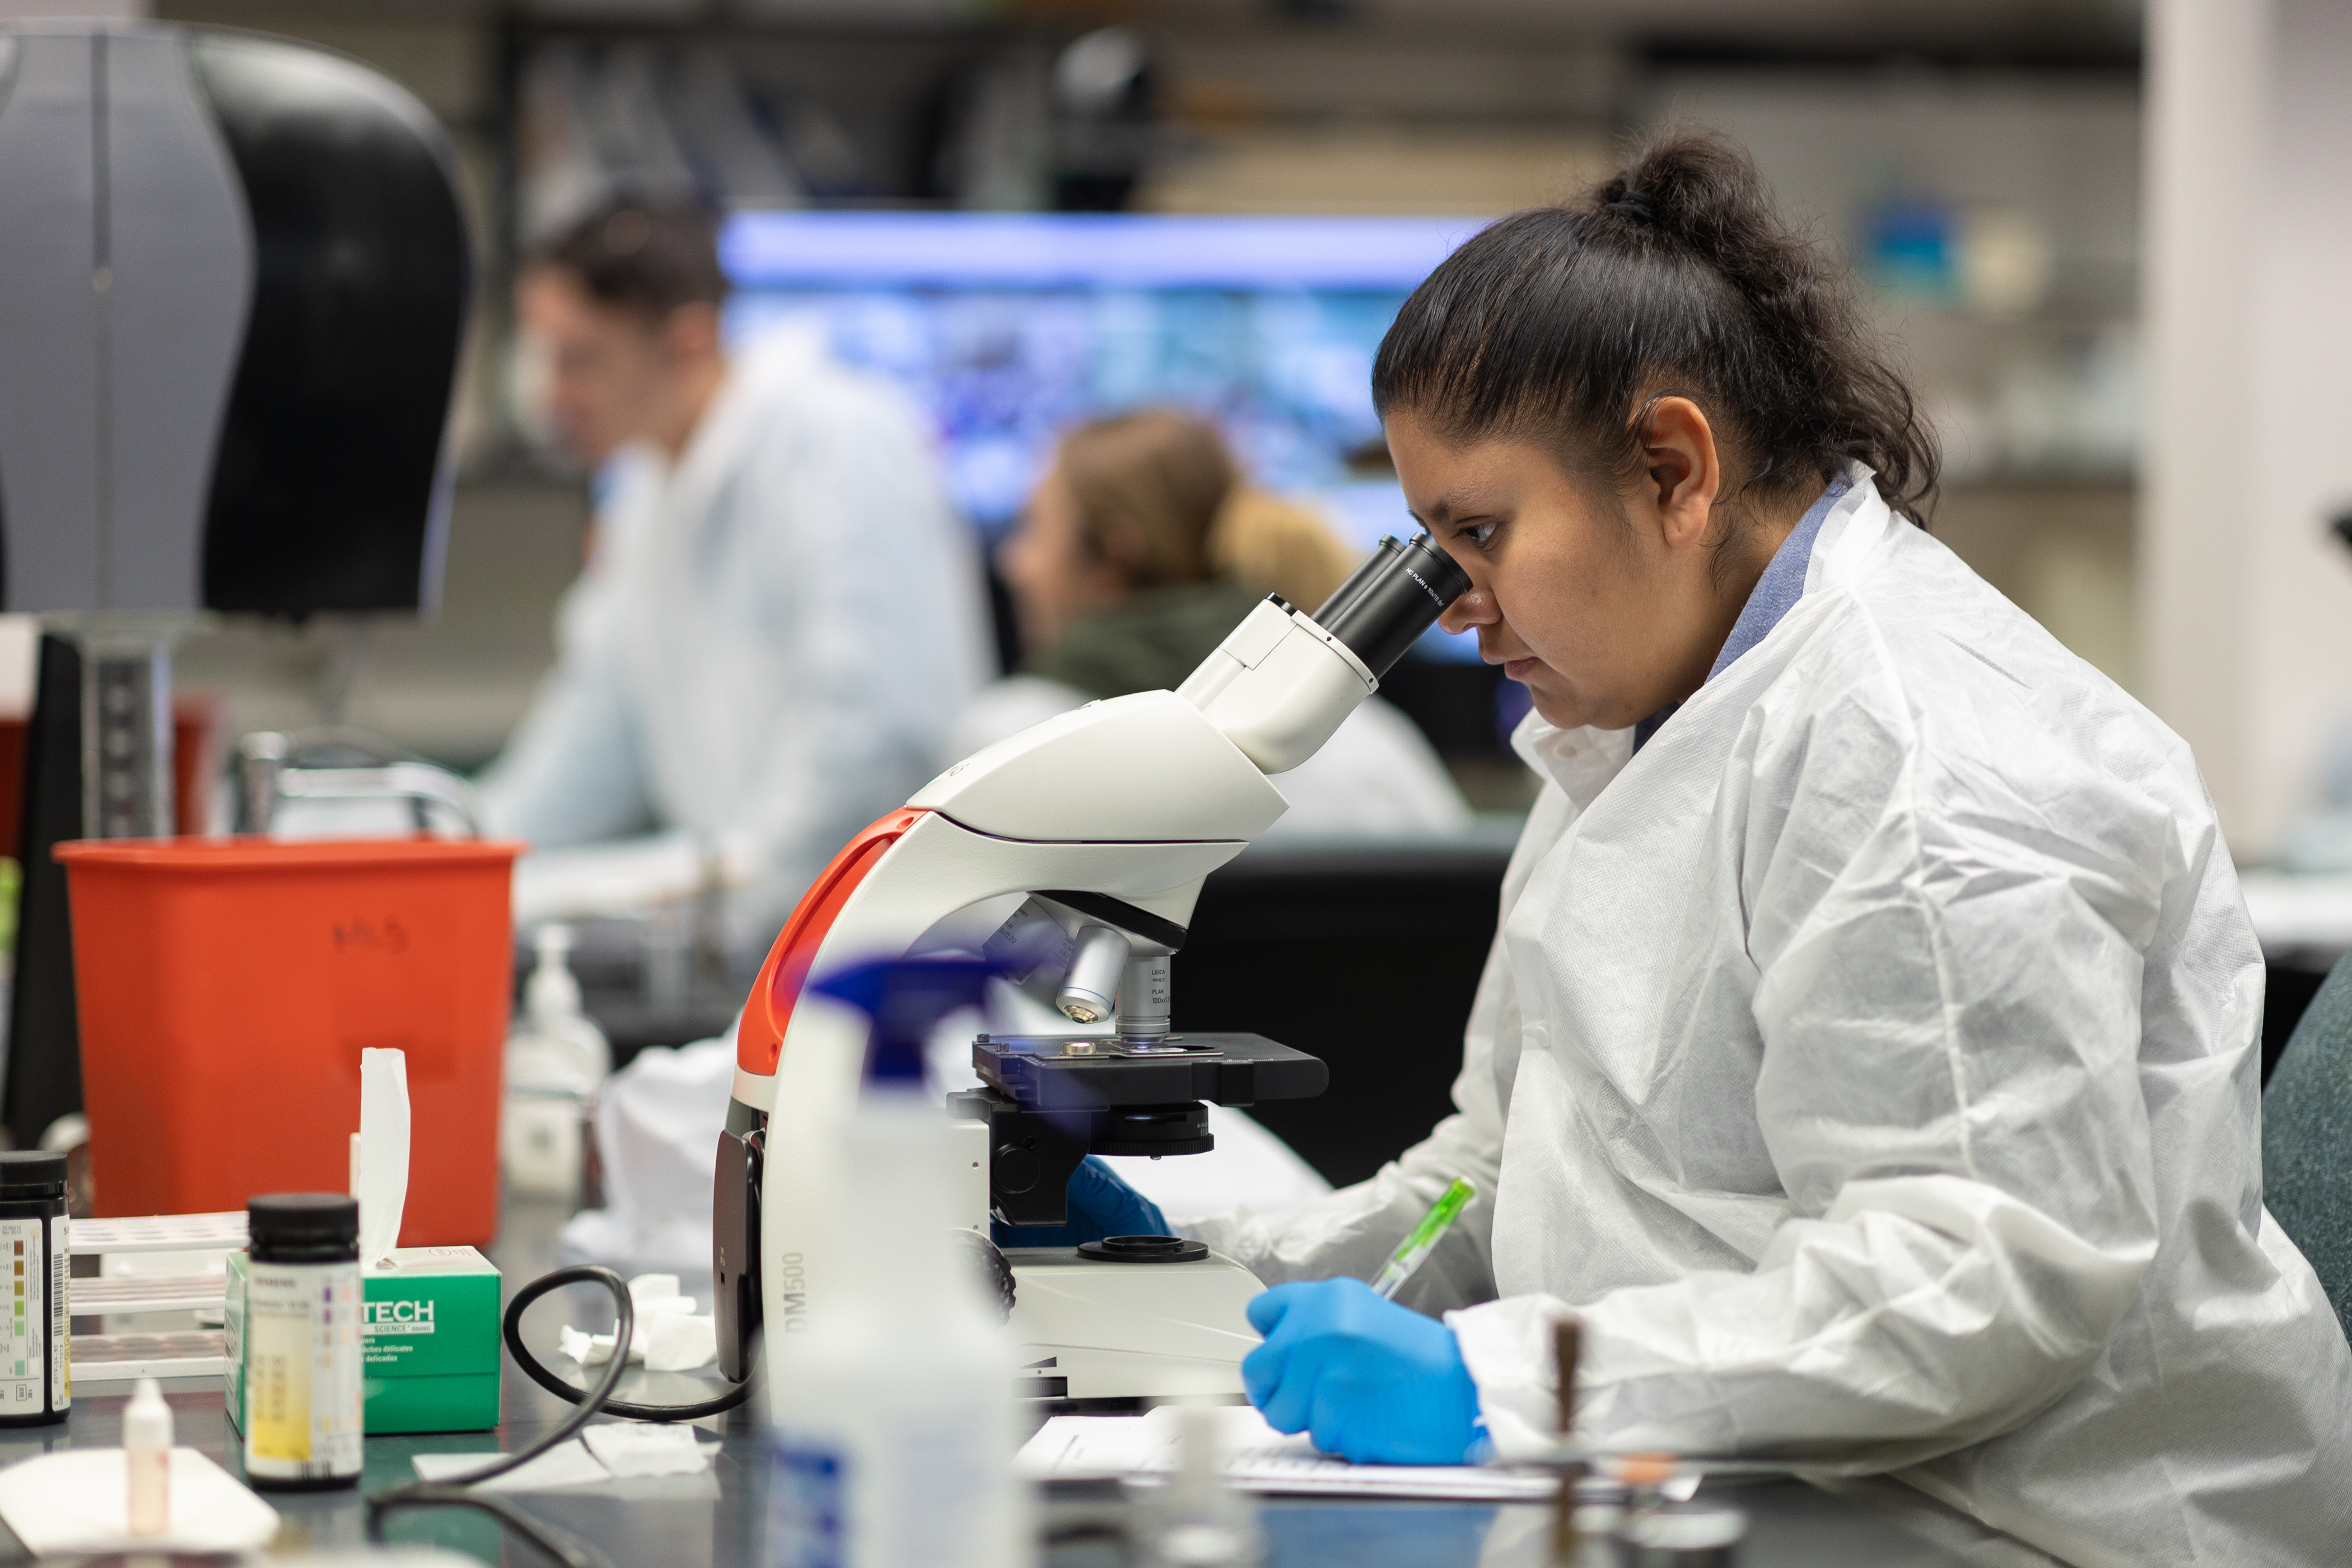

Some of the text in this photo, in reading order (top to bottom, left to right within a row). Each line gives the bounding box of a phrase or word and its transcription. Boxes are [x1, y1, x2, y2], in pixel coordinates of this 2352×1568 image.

[1406, 567, 1414, 576] HC
[1412, 573, 1426, 586] PLAN
[782, 1253, 808, 1333] DM500
[362, 1300, 435, 1322] TECH
